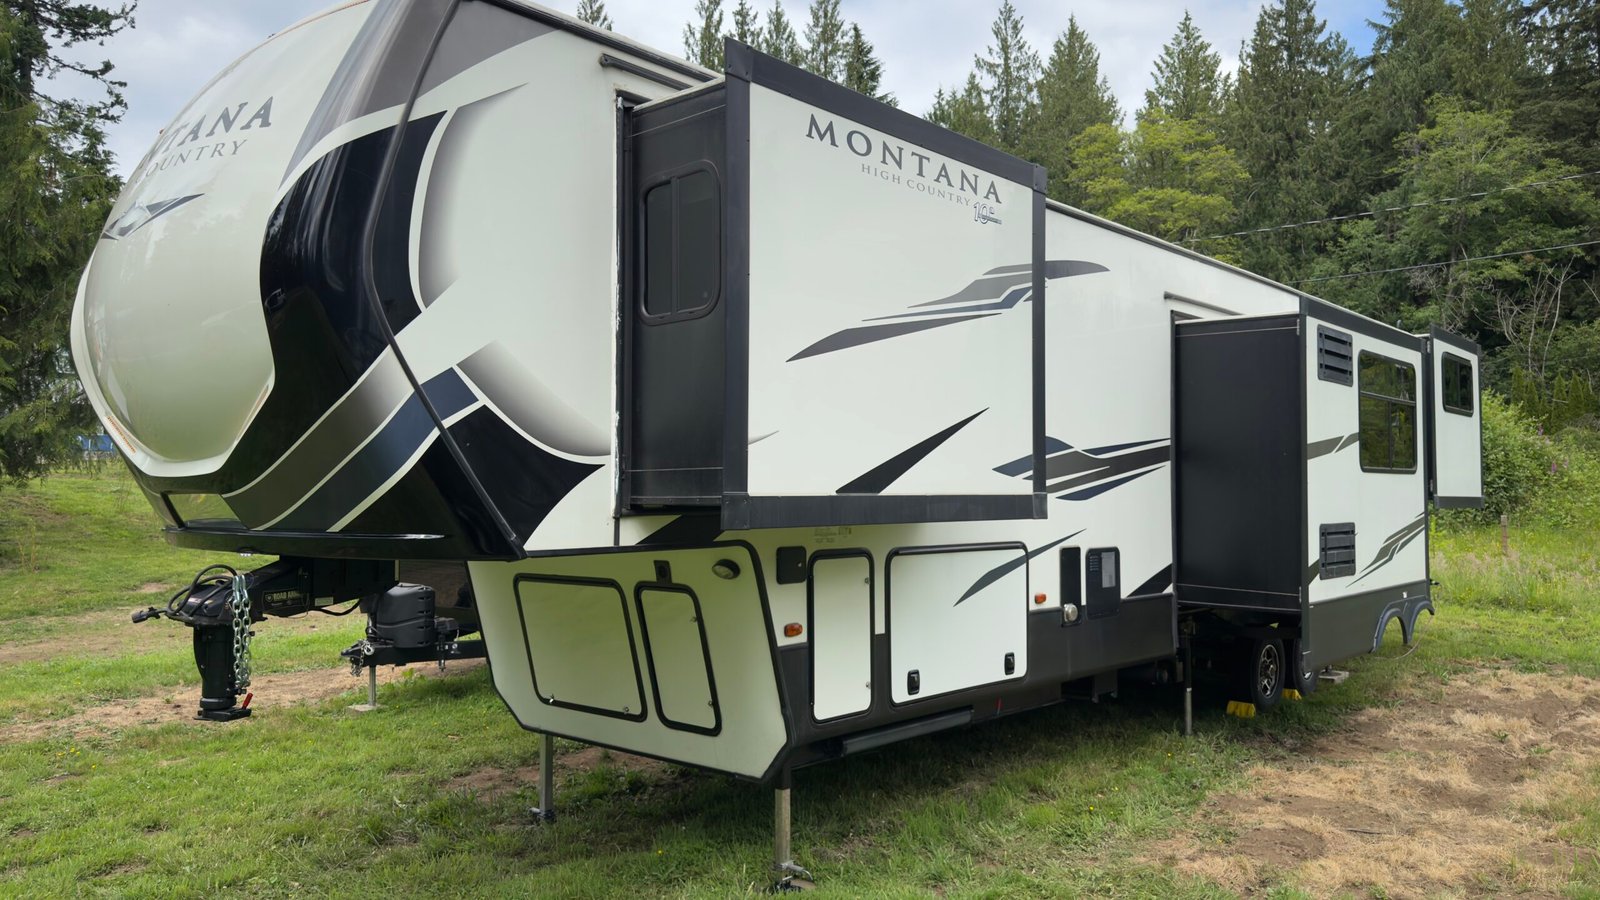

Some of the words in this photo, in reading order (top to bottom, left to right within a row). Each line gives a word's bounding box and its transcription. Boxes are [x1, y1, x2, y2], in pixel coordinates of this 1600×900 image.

[805, 113, 1002, 204] MONTANA
[861, 163, 900, 185] HIGH
[906, 179, 970, 206] COUNTRY
